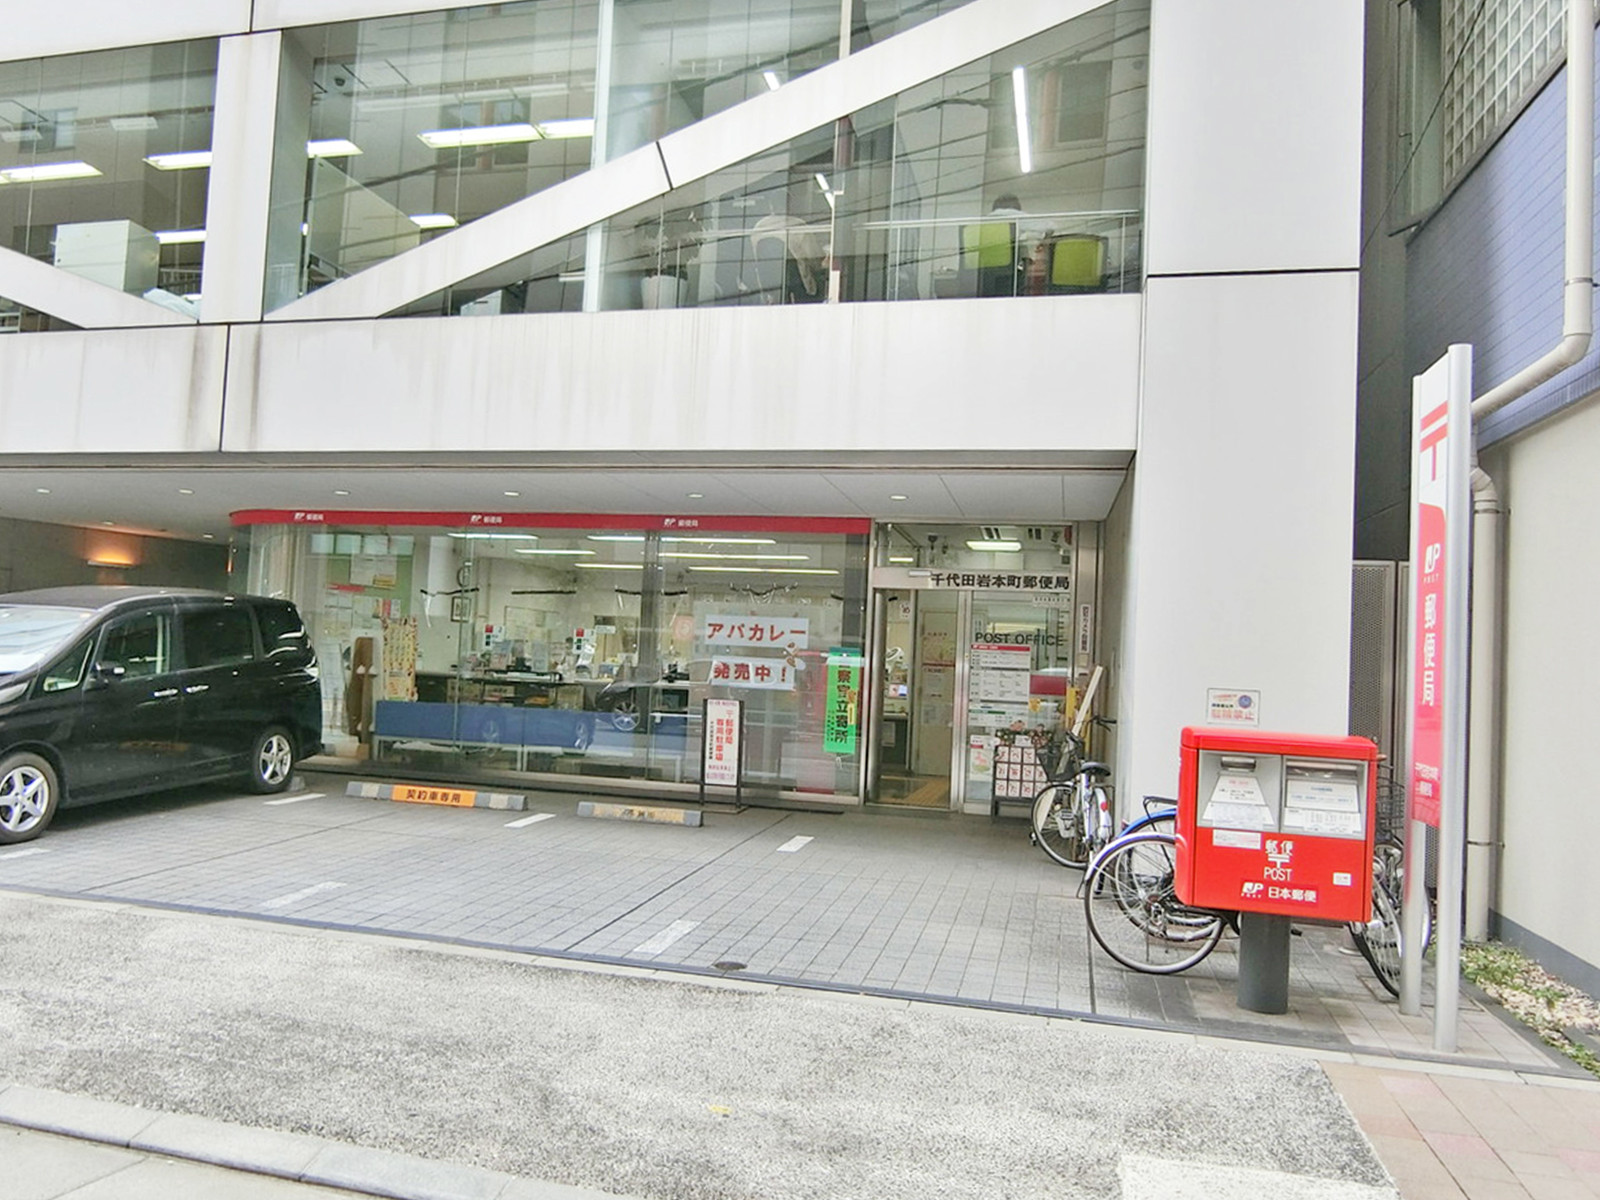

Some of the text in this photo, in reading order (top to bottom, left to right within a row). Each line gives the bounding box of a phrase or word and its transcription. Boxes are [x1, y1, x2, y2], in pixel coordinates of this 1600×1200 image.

[931, 572, 1070, 591] 千代田岩本町郵便局
[975, 632, 1066, 647] POST OFFICE
[1422, 592, 1437, 707] 郵便局
[835, 664, 852, 745] 察官立寄所
[406, 789, 462, 804] 契約車専用
[1265, 839, 1294, 857] 郵便
[1263, 866, 1293, 882] POST
[1268, 886, 1317, 903] 日本郵便
